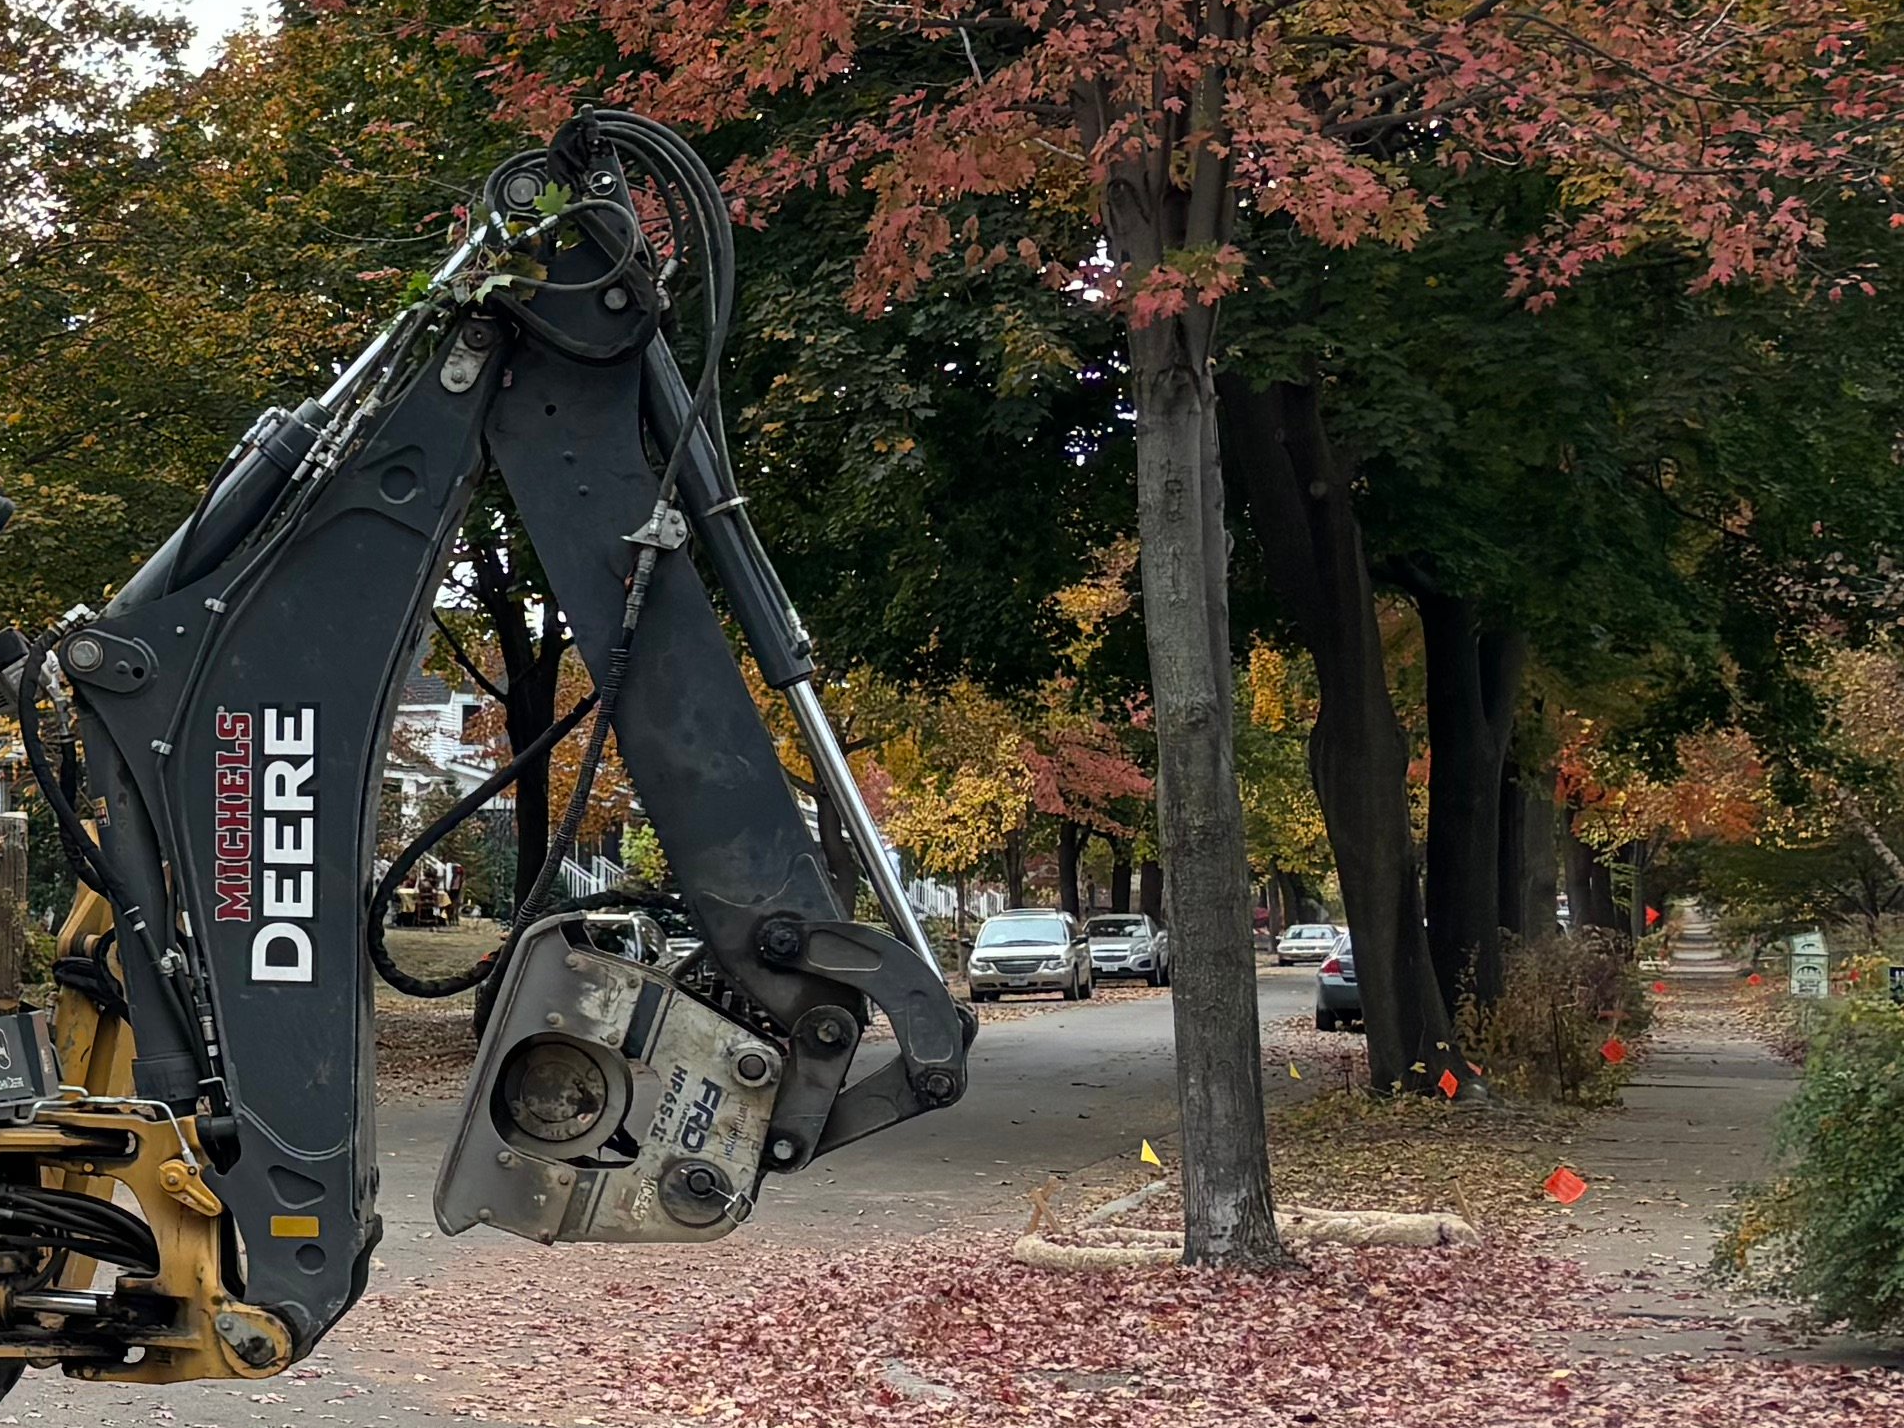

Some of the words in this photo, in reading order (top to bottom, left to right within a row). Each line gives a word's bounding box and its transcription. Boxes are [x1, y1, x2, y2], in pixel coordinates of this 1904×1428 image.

[215, 712, 252, 922] MICHELS
[252, 708, 314, 981] DEERE
[681, 1077, 723, 1153] FRD
